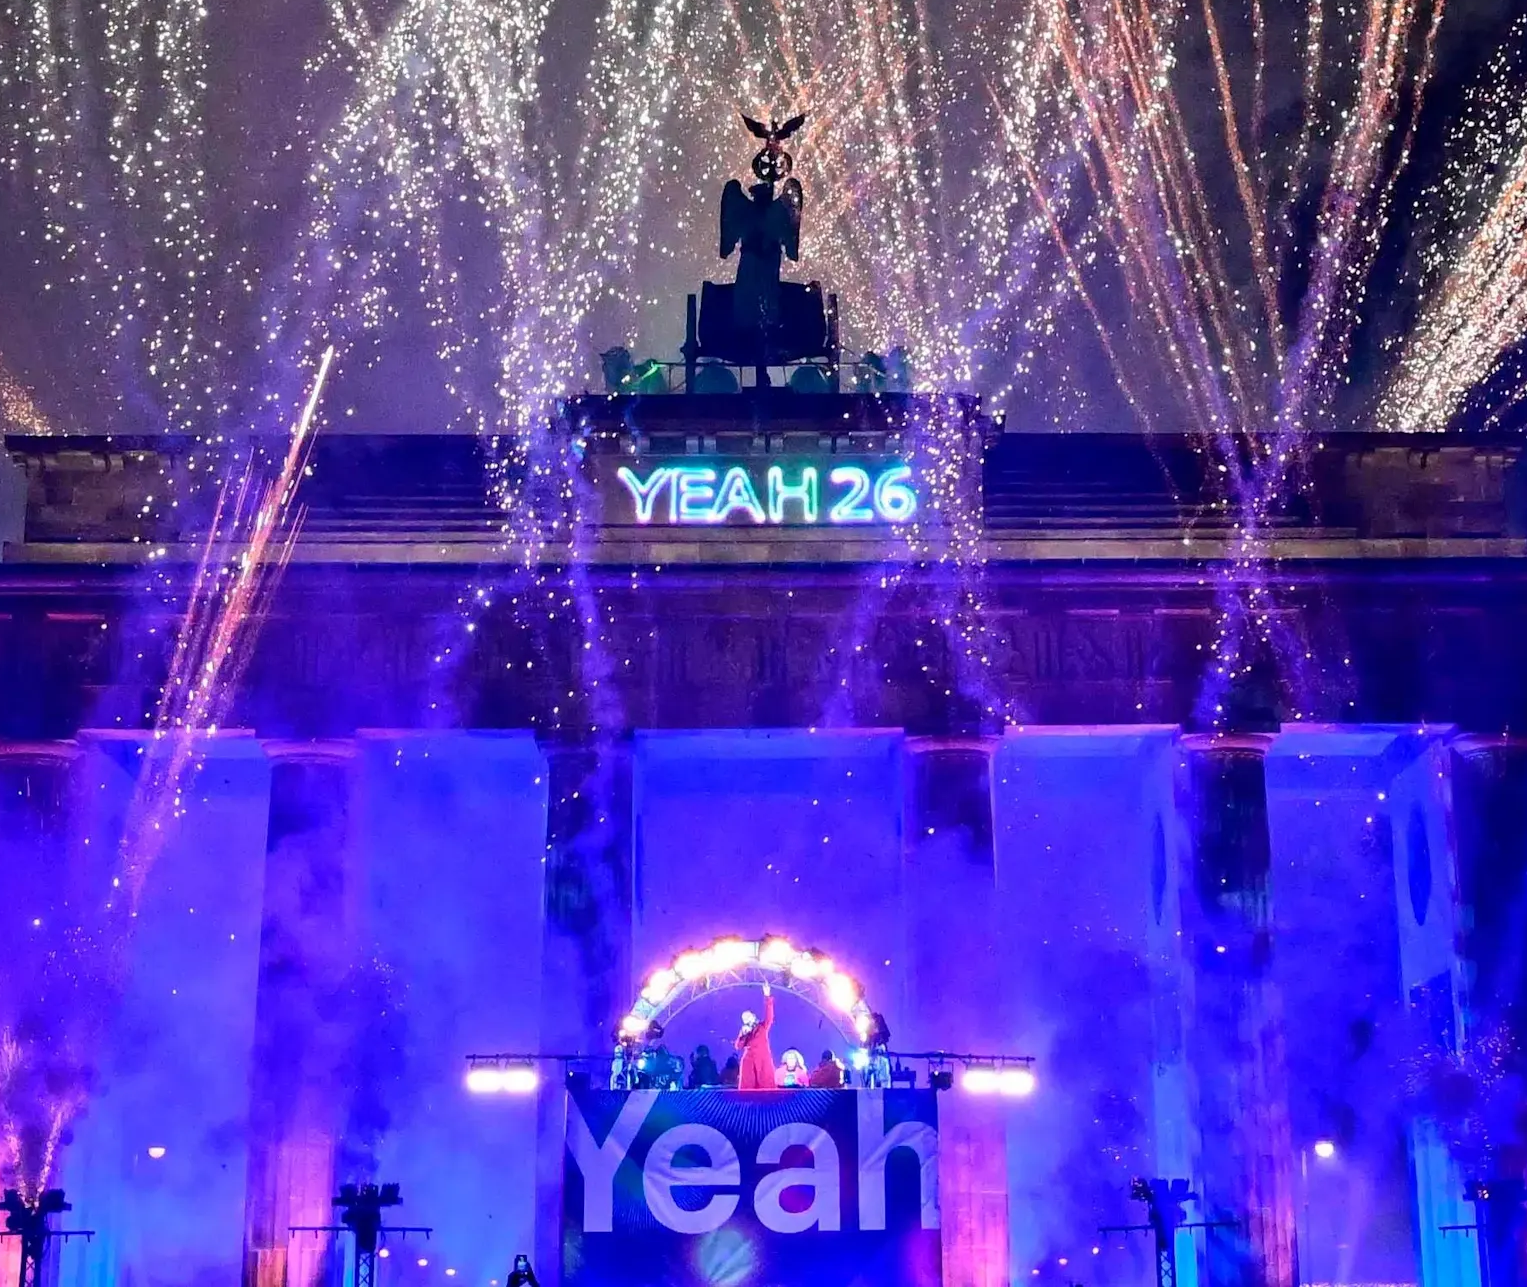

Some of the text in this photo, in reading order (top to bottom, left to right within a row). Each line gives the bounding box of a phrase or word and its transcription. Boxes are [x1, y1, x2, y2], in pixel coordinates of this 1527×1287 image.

[617, 466, 917, 523] YEAH 26
[567, 1089, 940, 1235] Yeah
